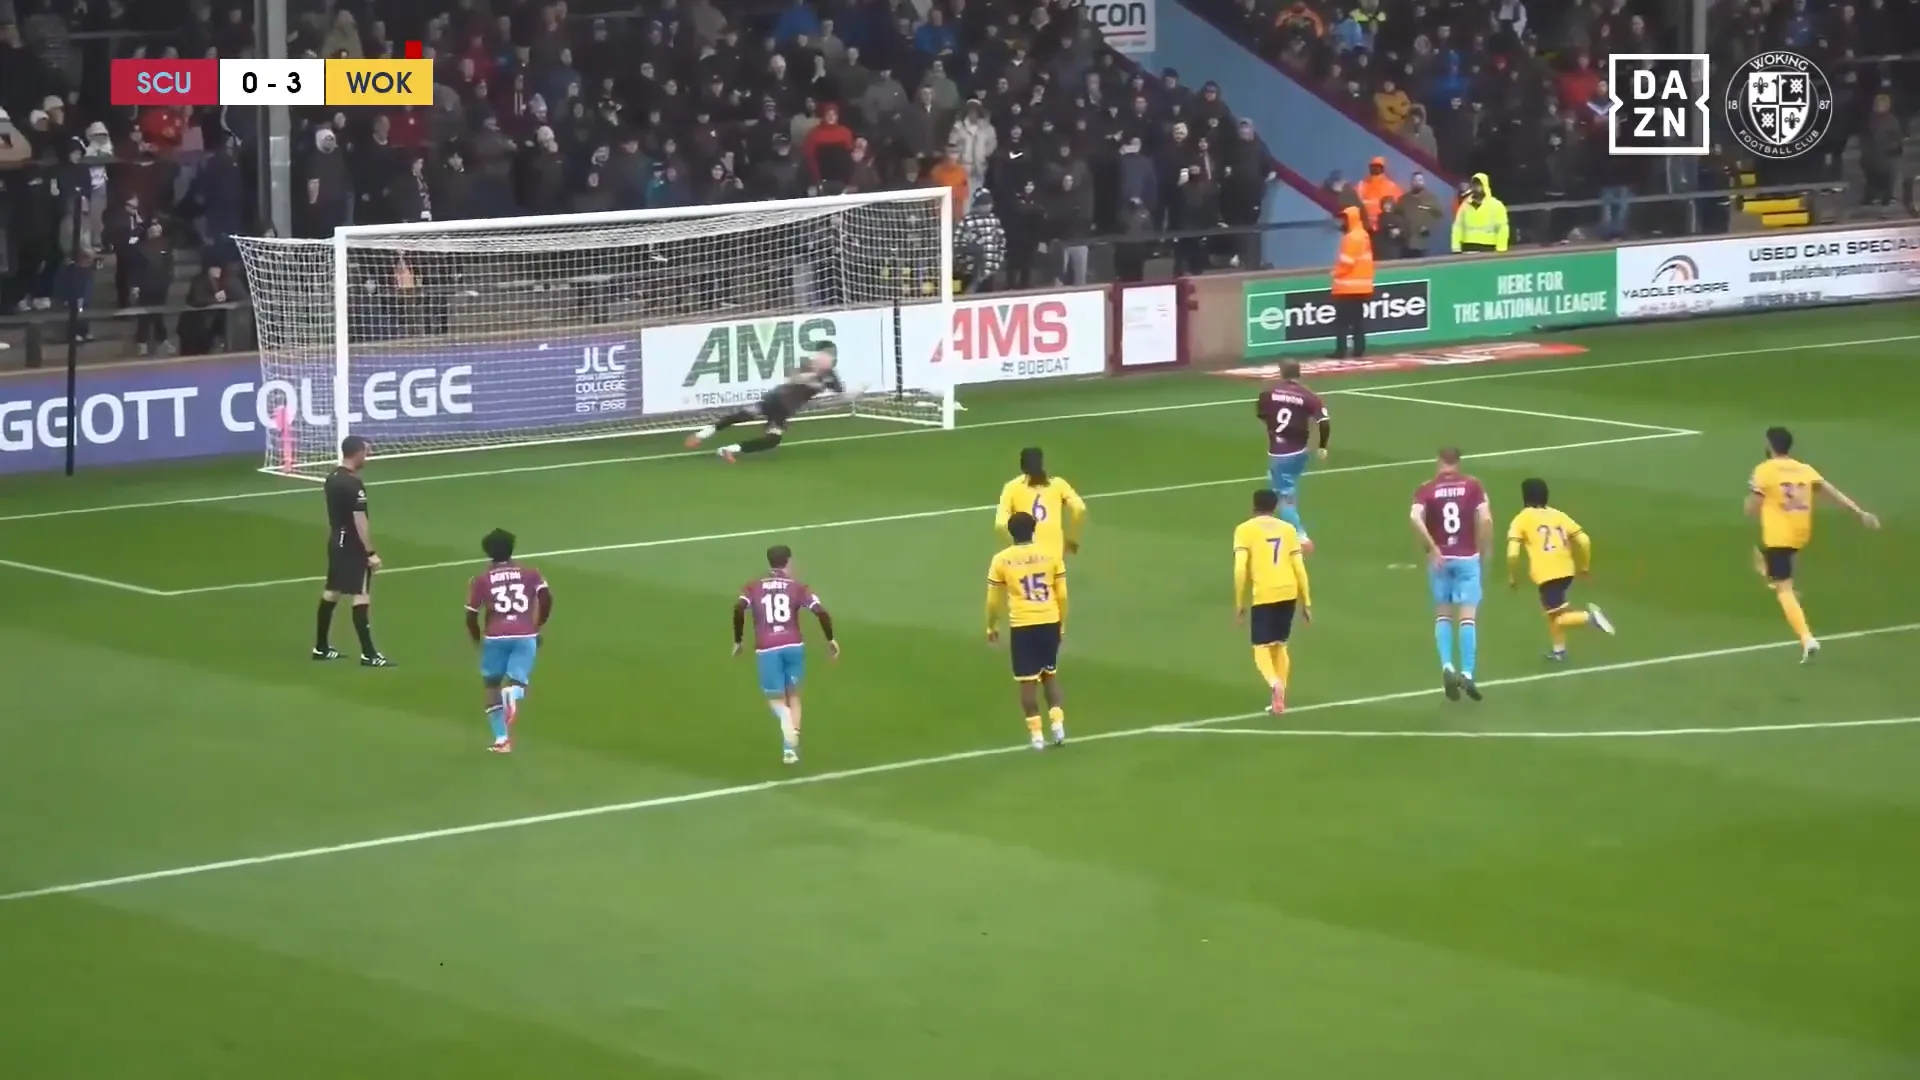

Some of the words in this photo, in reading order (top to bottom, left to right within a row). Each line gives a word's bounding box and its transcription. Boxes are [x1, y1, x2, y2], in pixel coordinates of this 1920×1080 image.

[1085, 2, 1146, 27] con
[1749, 246, 1798, 261] USED
[1803, 242, 1840, 258] CAR
[1498, 273, 1533, 295] HERE
[1537, 271, 1563, 292] FOR
[1622, 281, 1729, 298] YADDLETHORPE
[1260, 293, 1427, 330] enterise
[1453, 301, 1480, 324] THE
[1484, 296, 1552, 320] NATIONAL
[1555, 291, 1608, 313] LEAGUE
[930, 301, 1068, 363] AMS
[575, 345, 626, 374] JLC
[682, 318, 838, 387] AMS
[1275, 407, 1292, 433] 9
[1032, 494, 1047, 522] 6
[1442, 501, 1461, 534] 8
[1266, 537, 1281, 565] 7
[491, 583, 529, 613] 33
[1019, 572, 1049, 602] 15
[761, 593, 791, 624] 18
